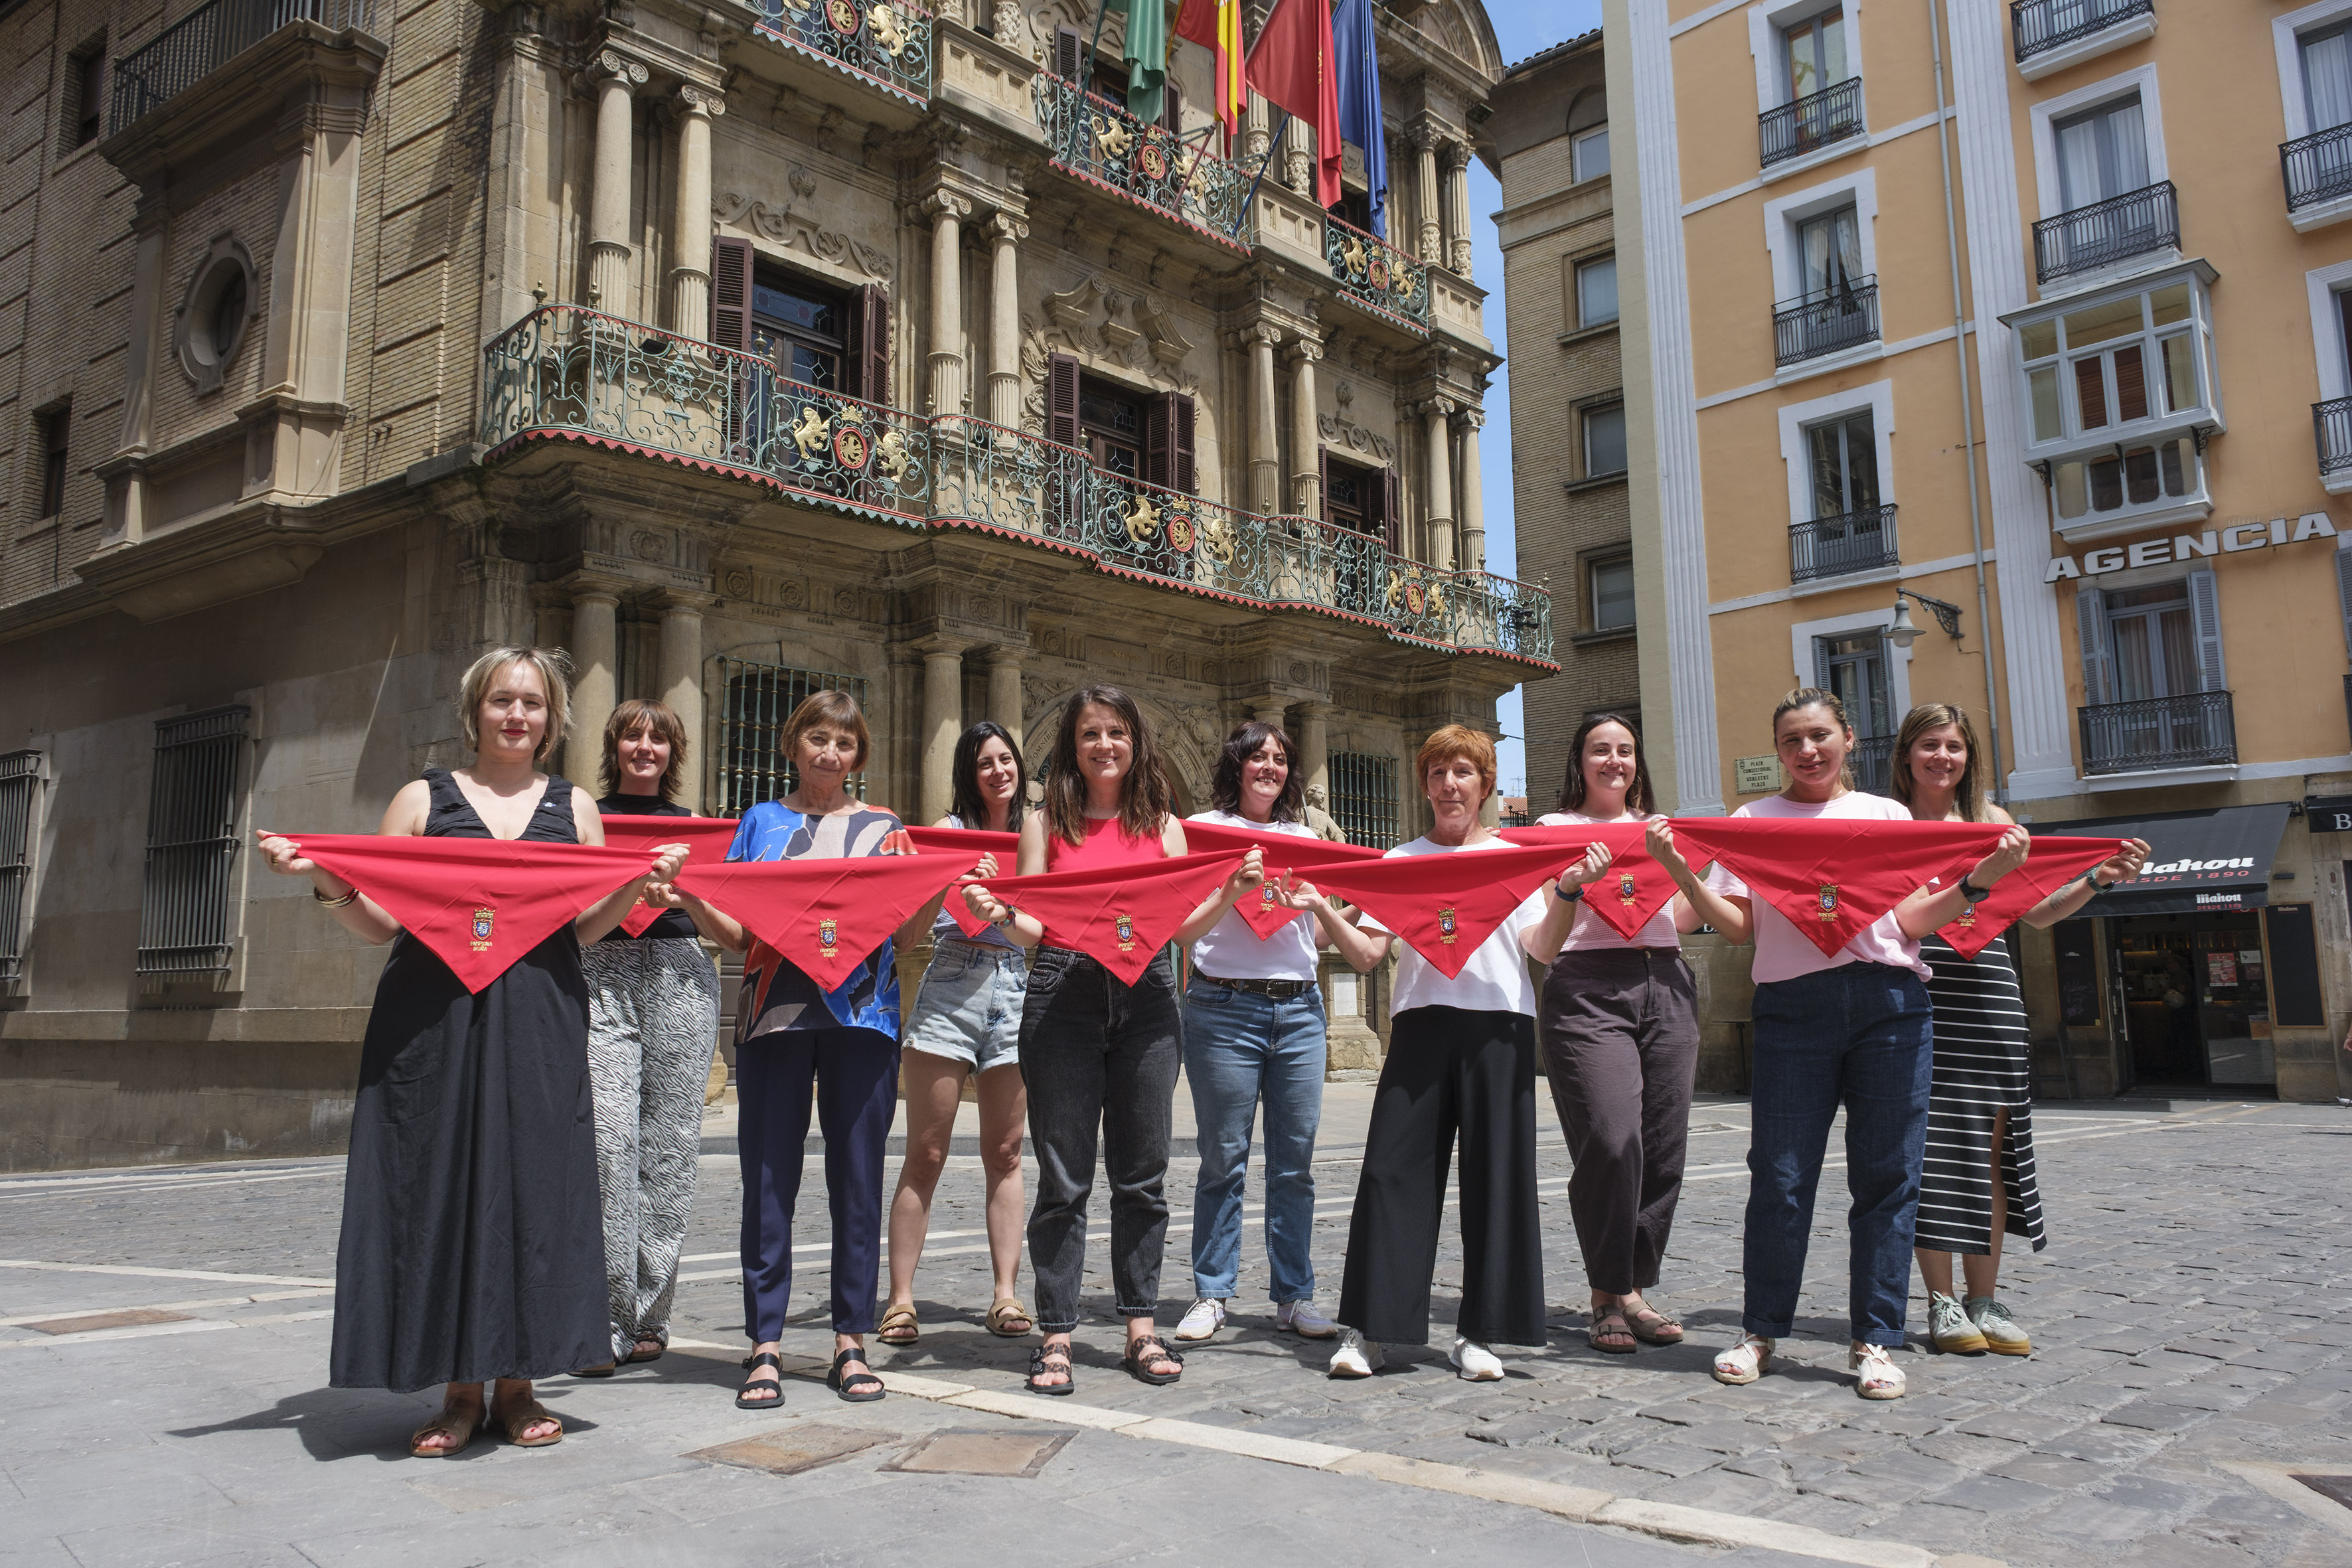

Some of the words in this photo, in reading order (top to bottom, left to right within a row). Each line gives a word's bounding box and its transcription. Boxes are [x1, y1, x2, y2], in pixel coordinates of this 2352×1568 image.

[2043, 511, 2338, 584] AGENCIA
[1032, 727, 1058, 759] OMNIBUS
[2196, 870, 2249, 880] 1890
[2195, 892, 2242, 903] Mahou
